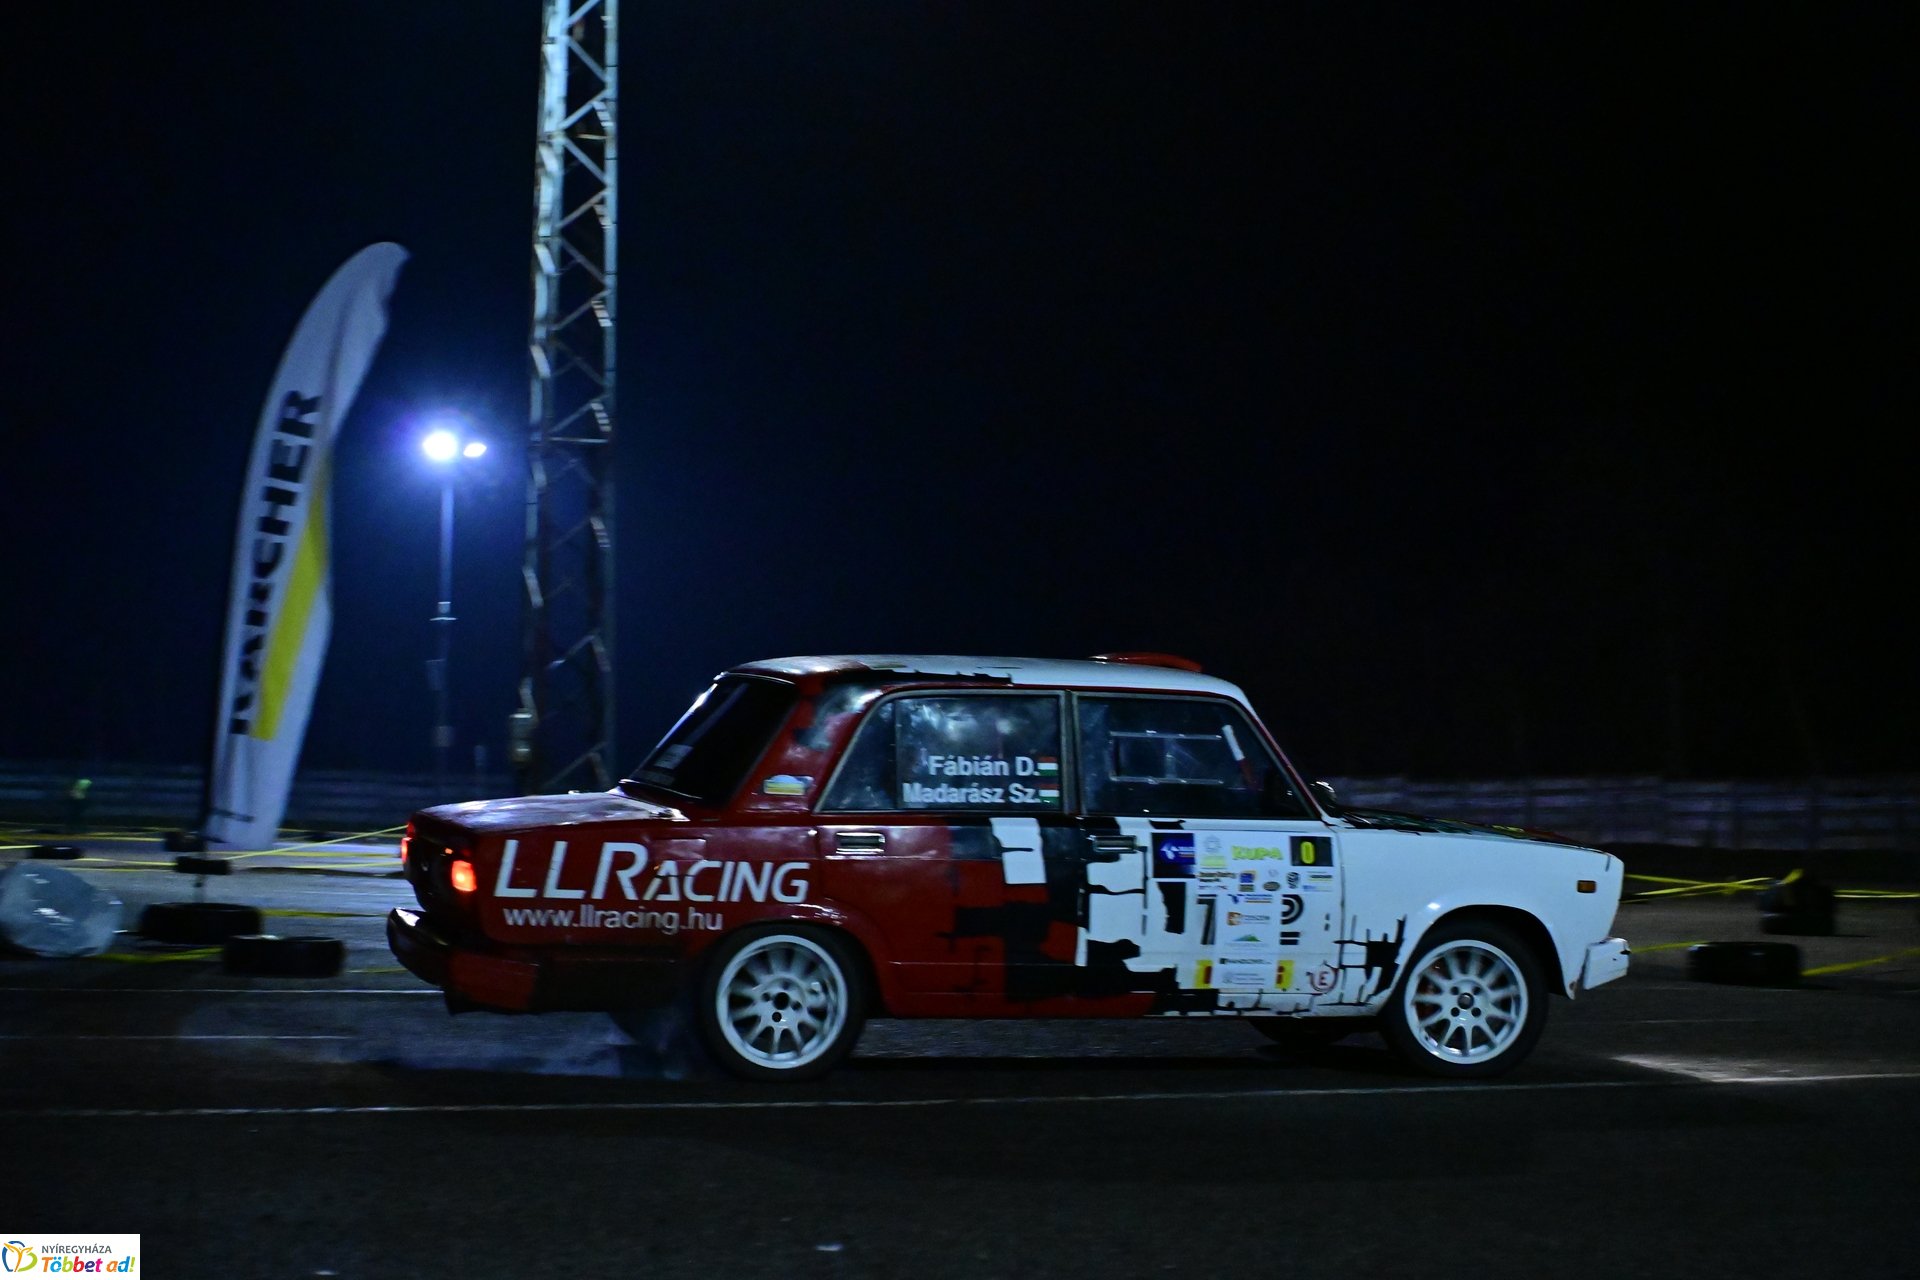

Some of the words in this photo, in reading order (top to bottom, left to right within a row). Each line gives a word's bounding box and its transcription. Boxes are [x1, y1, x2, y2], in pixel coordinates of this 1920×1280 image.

[928, 755, 1010, 777] Fábián
[1015, 757, 1040, 777] D.
[902, 783, 1006, 804] Madarász
[1300, 841, 1315, 864] 0
[504, 905, 723, 934] www.llracing.hu
